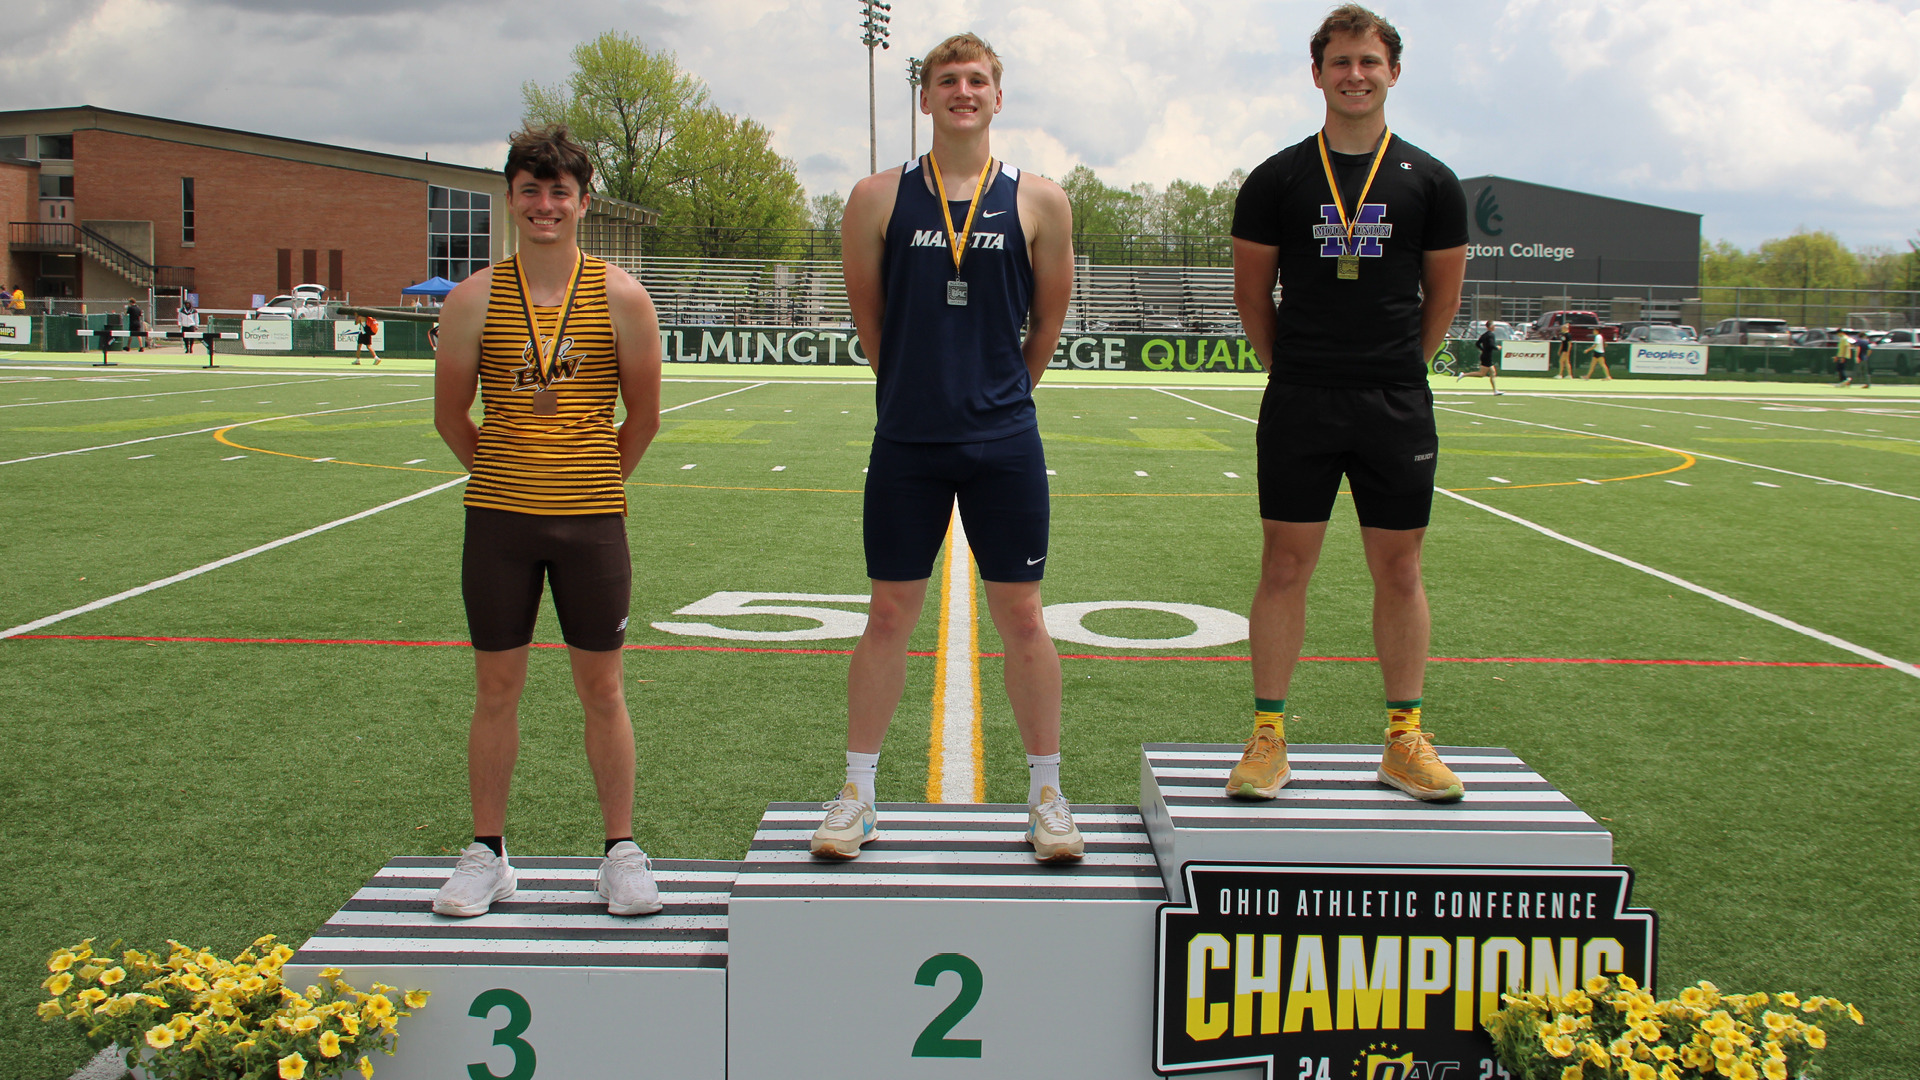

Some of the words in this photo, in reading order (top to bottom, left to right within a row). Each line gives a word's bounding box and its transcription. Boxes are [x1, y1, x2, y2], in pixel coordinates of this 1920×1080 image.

[910, 229, 1005, 251] MAITTA
[1315, 225, 1350, 237] MOUN
[1354, 225, 1390, 237] UNION
[1466, 243, 1504, 260] gton
[1510, 243, 1574, 261] College
[244, 331, 270, 341] Drayer
[337, 333, 358, 343] BEAC
[660, 330, 870, 365] ILMINGT
[1047, 337, 1126, 369] EGE
[1141, 338, 1263, 370] QUAK
[1637, 349, 1685, 360] Peoples
[1219, 888, 1280, 916] OHIO
[1296, 889, 1418, 918] ATHLETIC
[1434, 891, 1597, 919] CONFERENCE
[911, 952, 983, 1058] 2
[467, 988, 537, 1080] 3
[1299, 1056, 1331, 1080] 24
